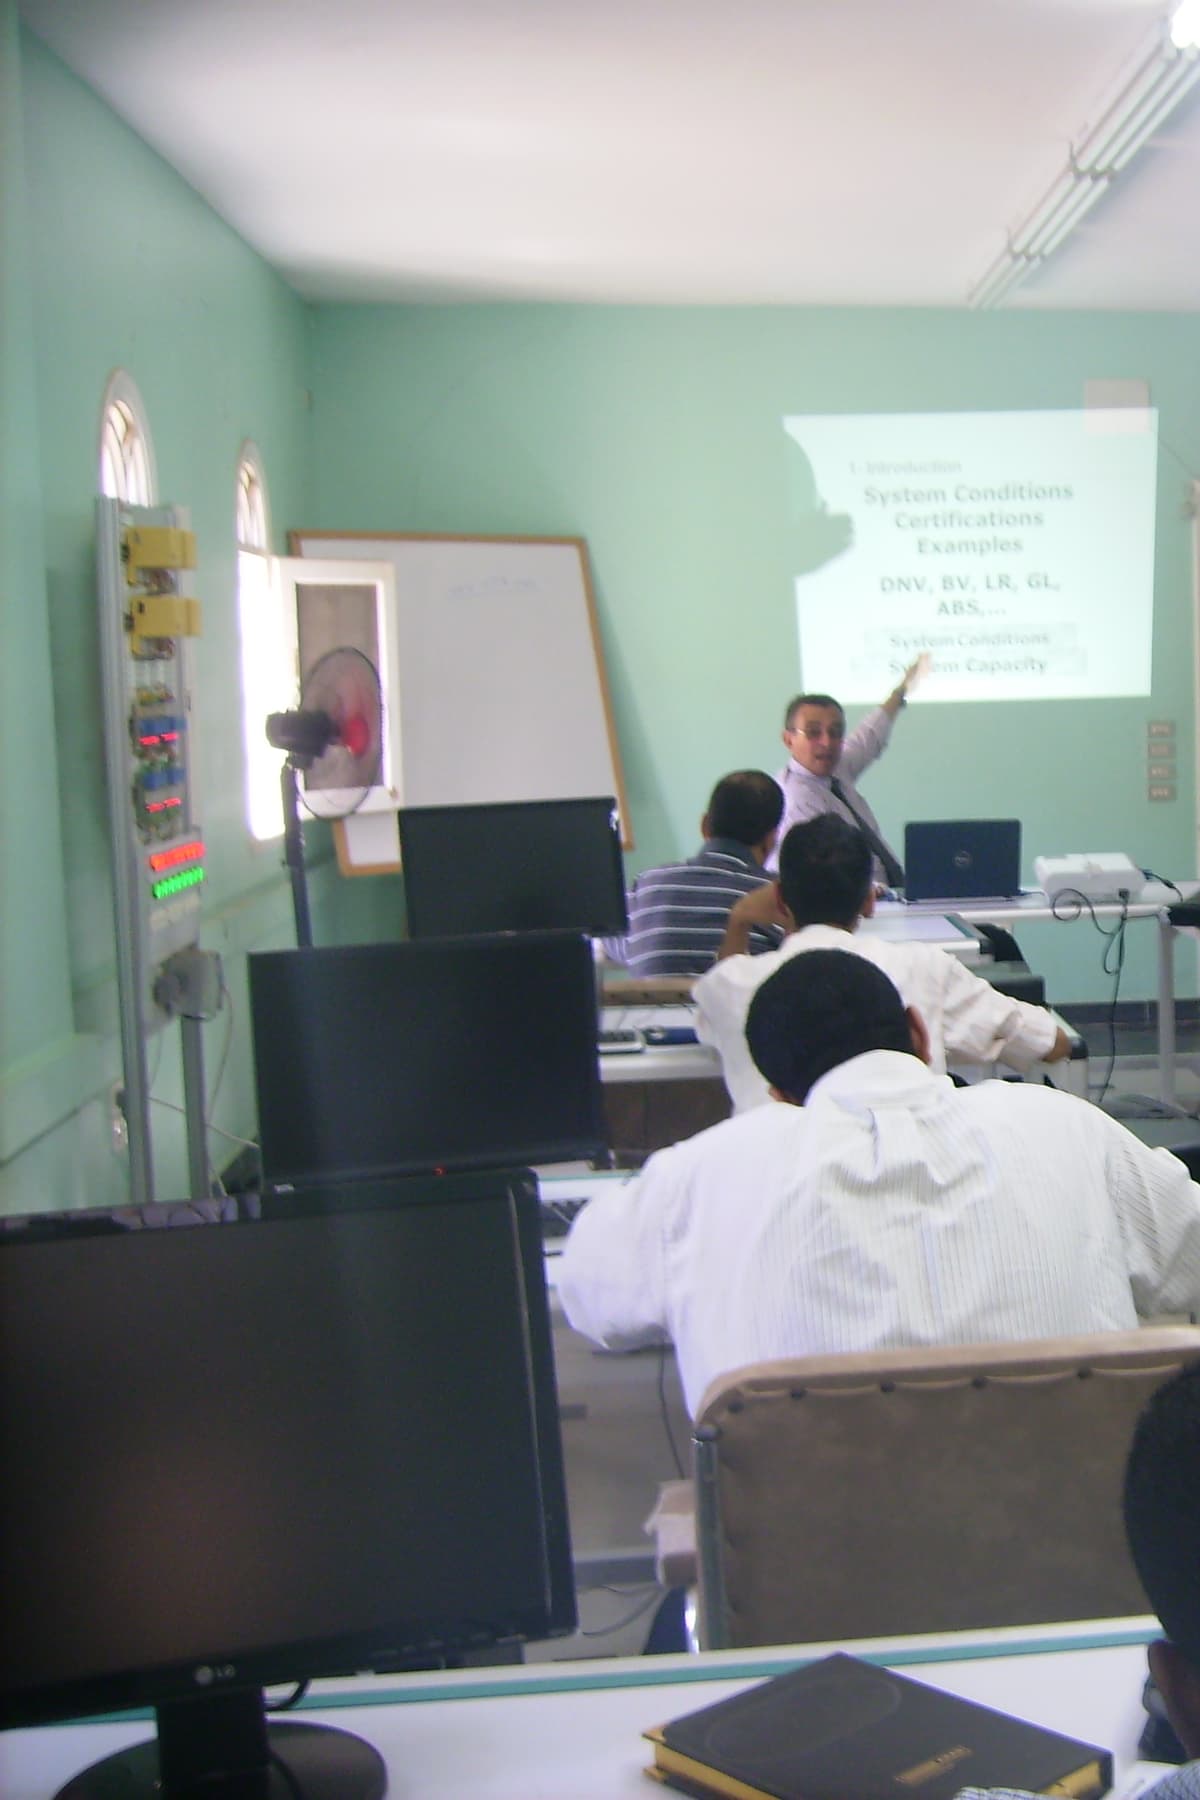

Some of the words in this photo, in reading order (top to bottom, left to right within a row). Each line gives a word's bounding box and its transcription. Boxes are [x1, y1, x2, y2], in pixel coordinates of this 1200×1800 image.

[866, 459, 963, 475] Introduction
[863, 486, 947, 507] System
[954, 481, 1075, 503] Conditions
[895, 510, 1045, 530] Certifications
[916, 535, 1023, 557] Examples
[880, 575, 934, 595] DNV,
[942, 574, 977, 594] BV,
[985, 574, 1018, 593] LR,
[1027, 571, 1062, 592] GL,
[889, 633, 955, 651] System
[957, 629, 1051, 648] Conditions
[888, 658, 960, 677] Syem
[965, 655, 1049, 676] Capacity
